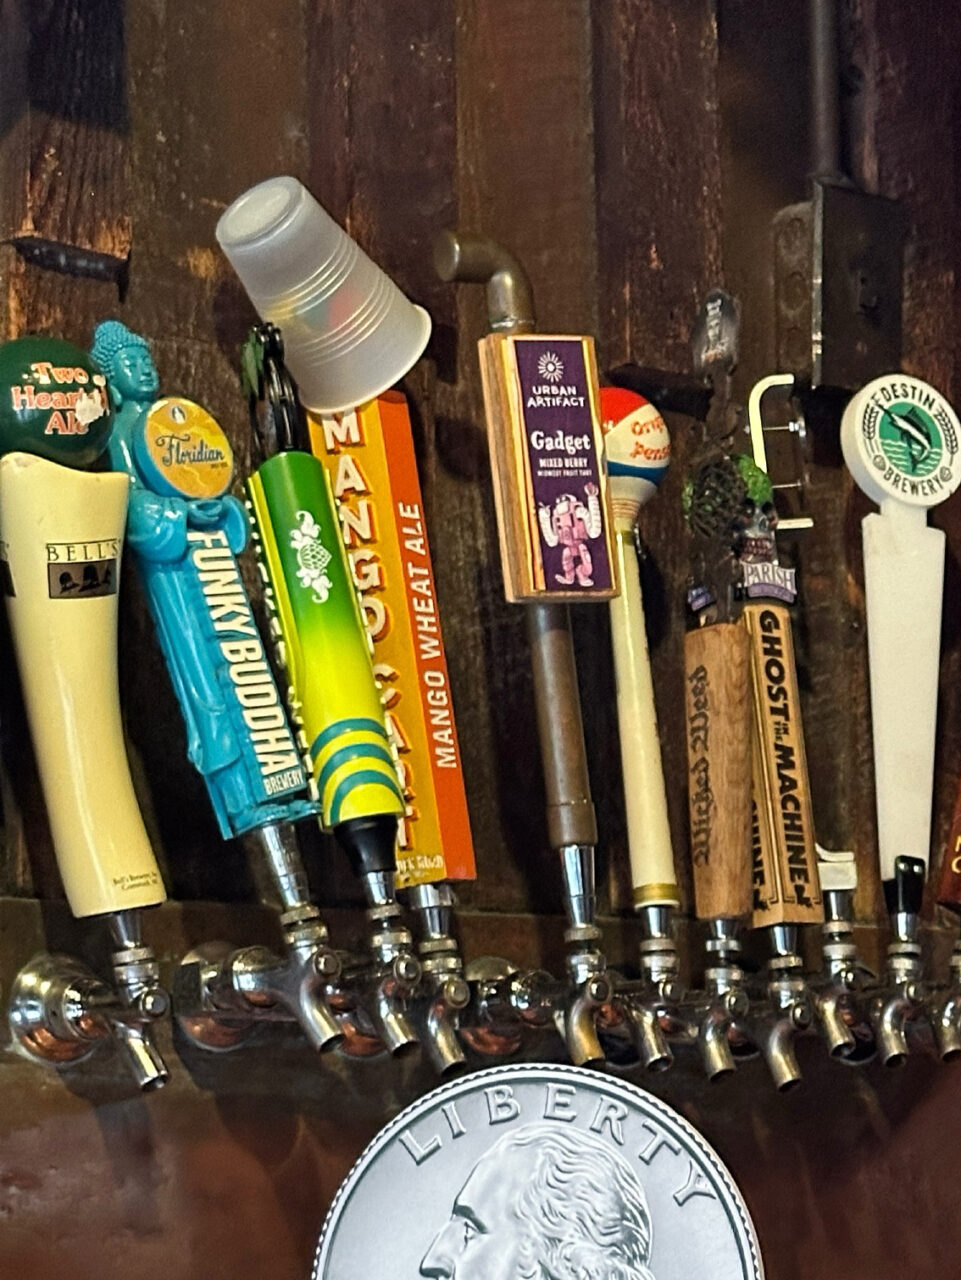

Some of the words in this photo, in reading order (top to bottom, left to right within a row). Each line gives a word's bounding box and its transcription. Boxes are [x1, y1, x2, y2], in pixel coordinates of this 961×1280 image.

[30, 361, 89, 384] Two
[532, 384, 577, 396] URBAN
[526, 396, 585, 409] ARTIFACT
[880, 383, 935, 411] DESTIN
[155, 434, 225, 467] Floridian
[530, 429, 591, 456] Gadget
[883, 467, 944, 497] BREWERY
[322, 407, 387, 640] MANGO
[397, 501, 427, 556] ALE
[46, 541, 118, 562] BELL'S
[186, 529, 257, 640] FUNKY
[745, 563, 795, 592] PARISH
[407, 561, 442, 661] WHEAT
[758, 609, 790, 722] GHOST
[219, 637, 300, 777] BUDDHA
[424, 669, 457, 769] MANGO
[687, 664, 710, 753] Weed
[262, 771, 304, 797] BREWERY
[773, 742, 810, 887] MACHINE
[399, 1082, 717, 1207] LIBERTY
